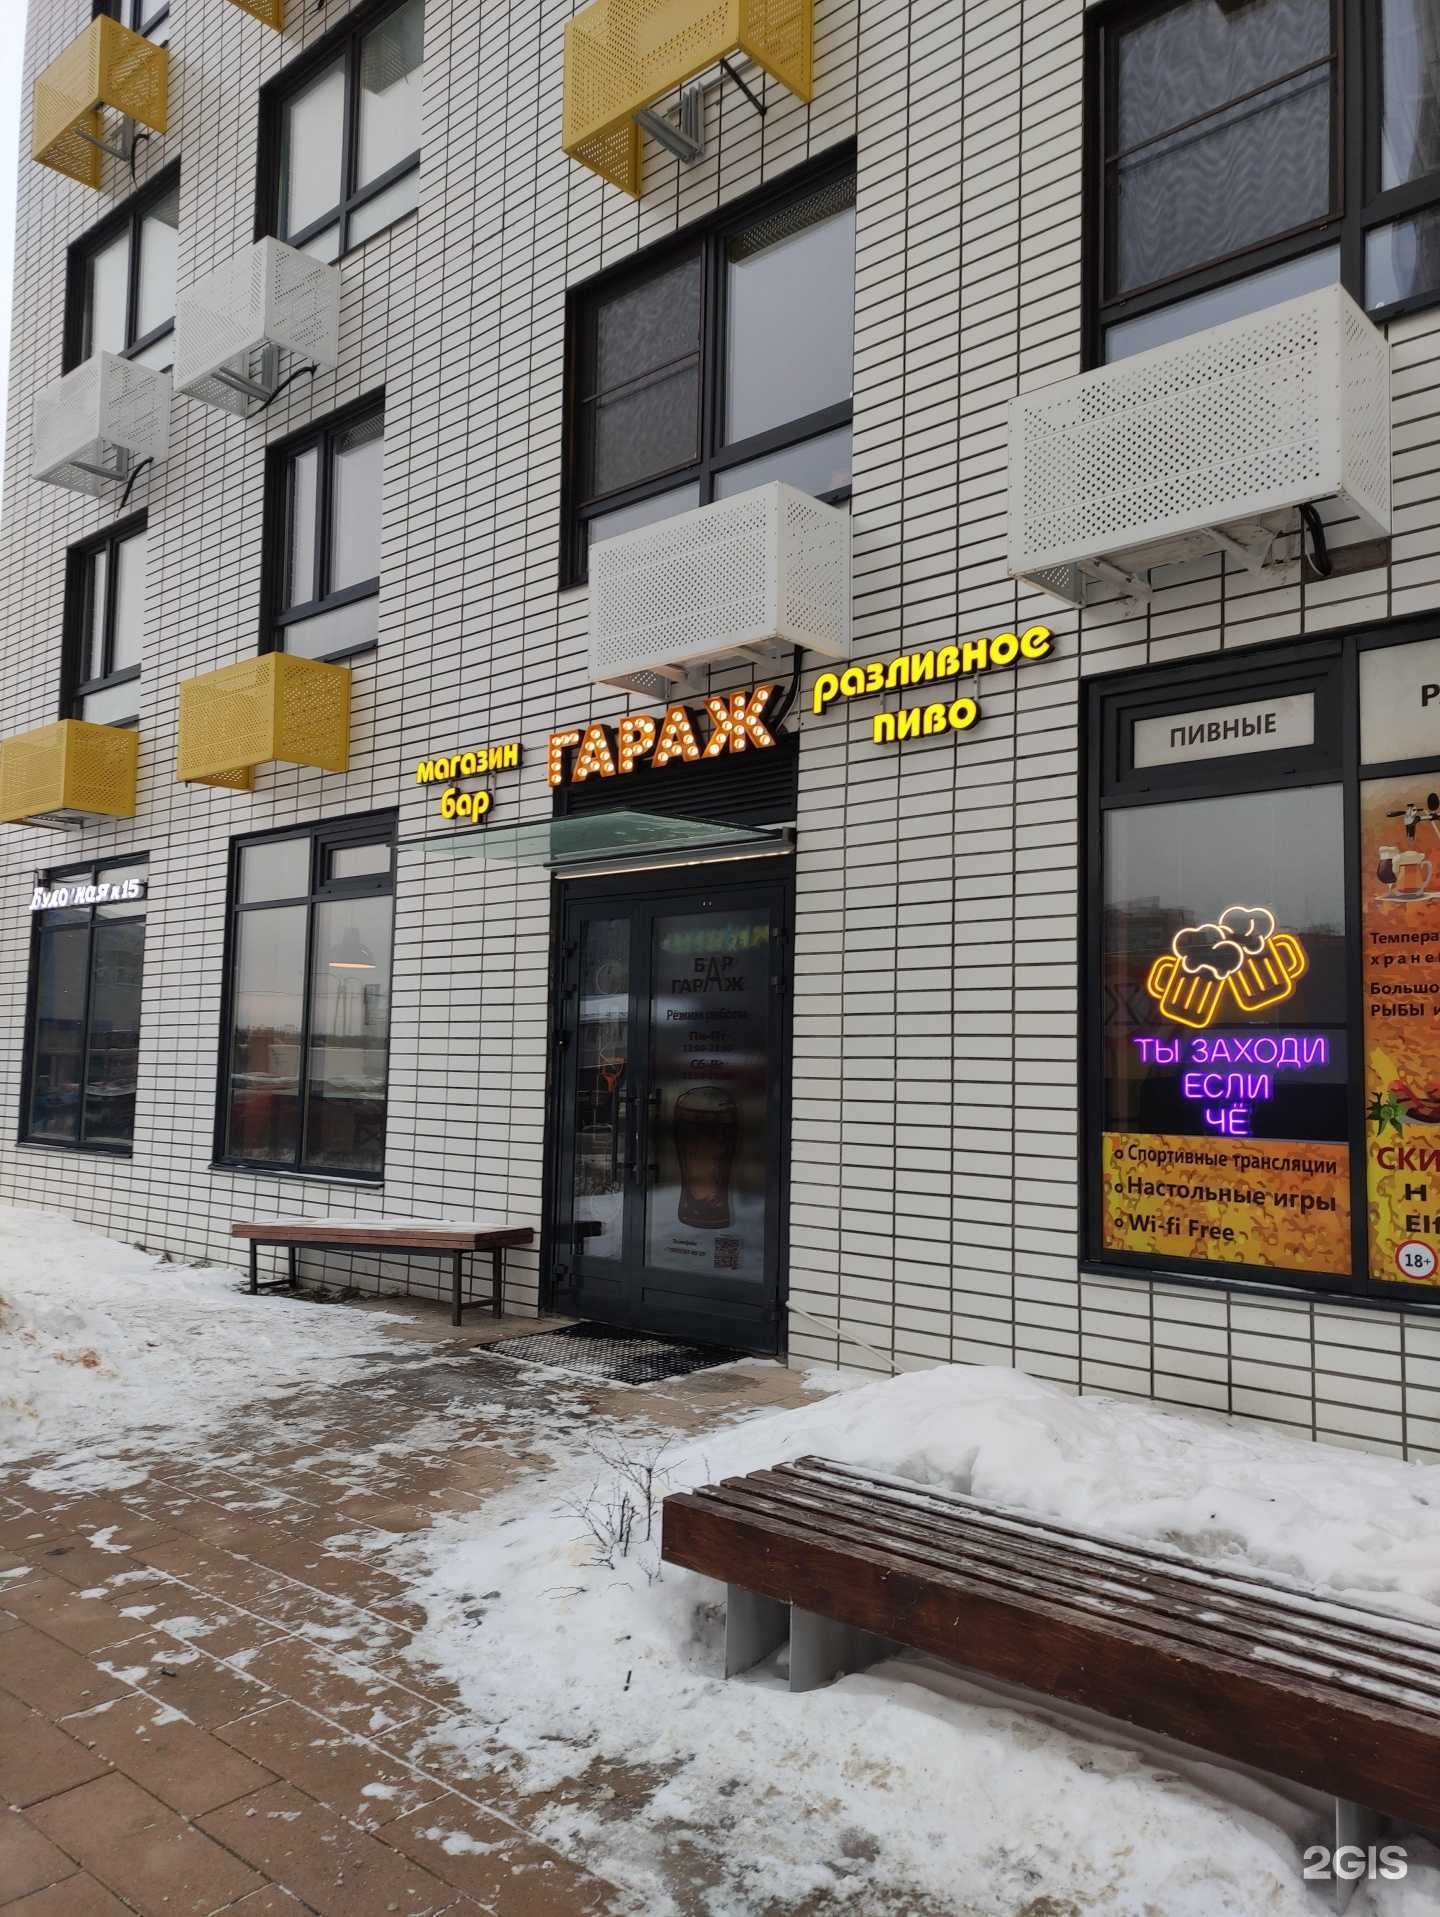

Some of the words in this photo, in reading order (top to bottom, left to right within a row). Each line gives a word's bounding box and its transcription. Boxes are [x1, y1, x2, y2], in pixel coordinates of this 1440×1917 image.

[812, 624, 1051, 715] разливное
[1421, 683, 1440, 708] Р
[547, 685, 779, 788] ГАРАЖ
[872, 696, 978, 744] пиво
[1169, 712, 1277, 748] ПИВНЫЕ
[415, 742, 521, 785] магазин
[440, 788, 490, 823] бар
[1369, 953, 1440, 968] хране
[1370, 1003, 1425, 1017] РЫБЫ
[1134, 1037, 1179, 1064] ТЫ
[1190, 1036, 1326, 1069] ЗАХОДИ
[1183, 1072, 1270, 1100] ЕСЛИ
[1204, 1103, 1250, 1136] ЧЁ
[1126, 1143, 1229, 1168] Спортивные
[1231, 1153, 1338, 1177] трансляции
[1126, 1175, 1266, 1206] Настольные
[1272, 1193, 1338, 1216] игры
[1127, 1213, 1182, 1236] Wi-fi
[1187, 1218, 1236, 1242] Free
[1404, 1253, 1432, 1268] 18+
